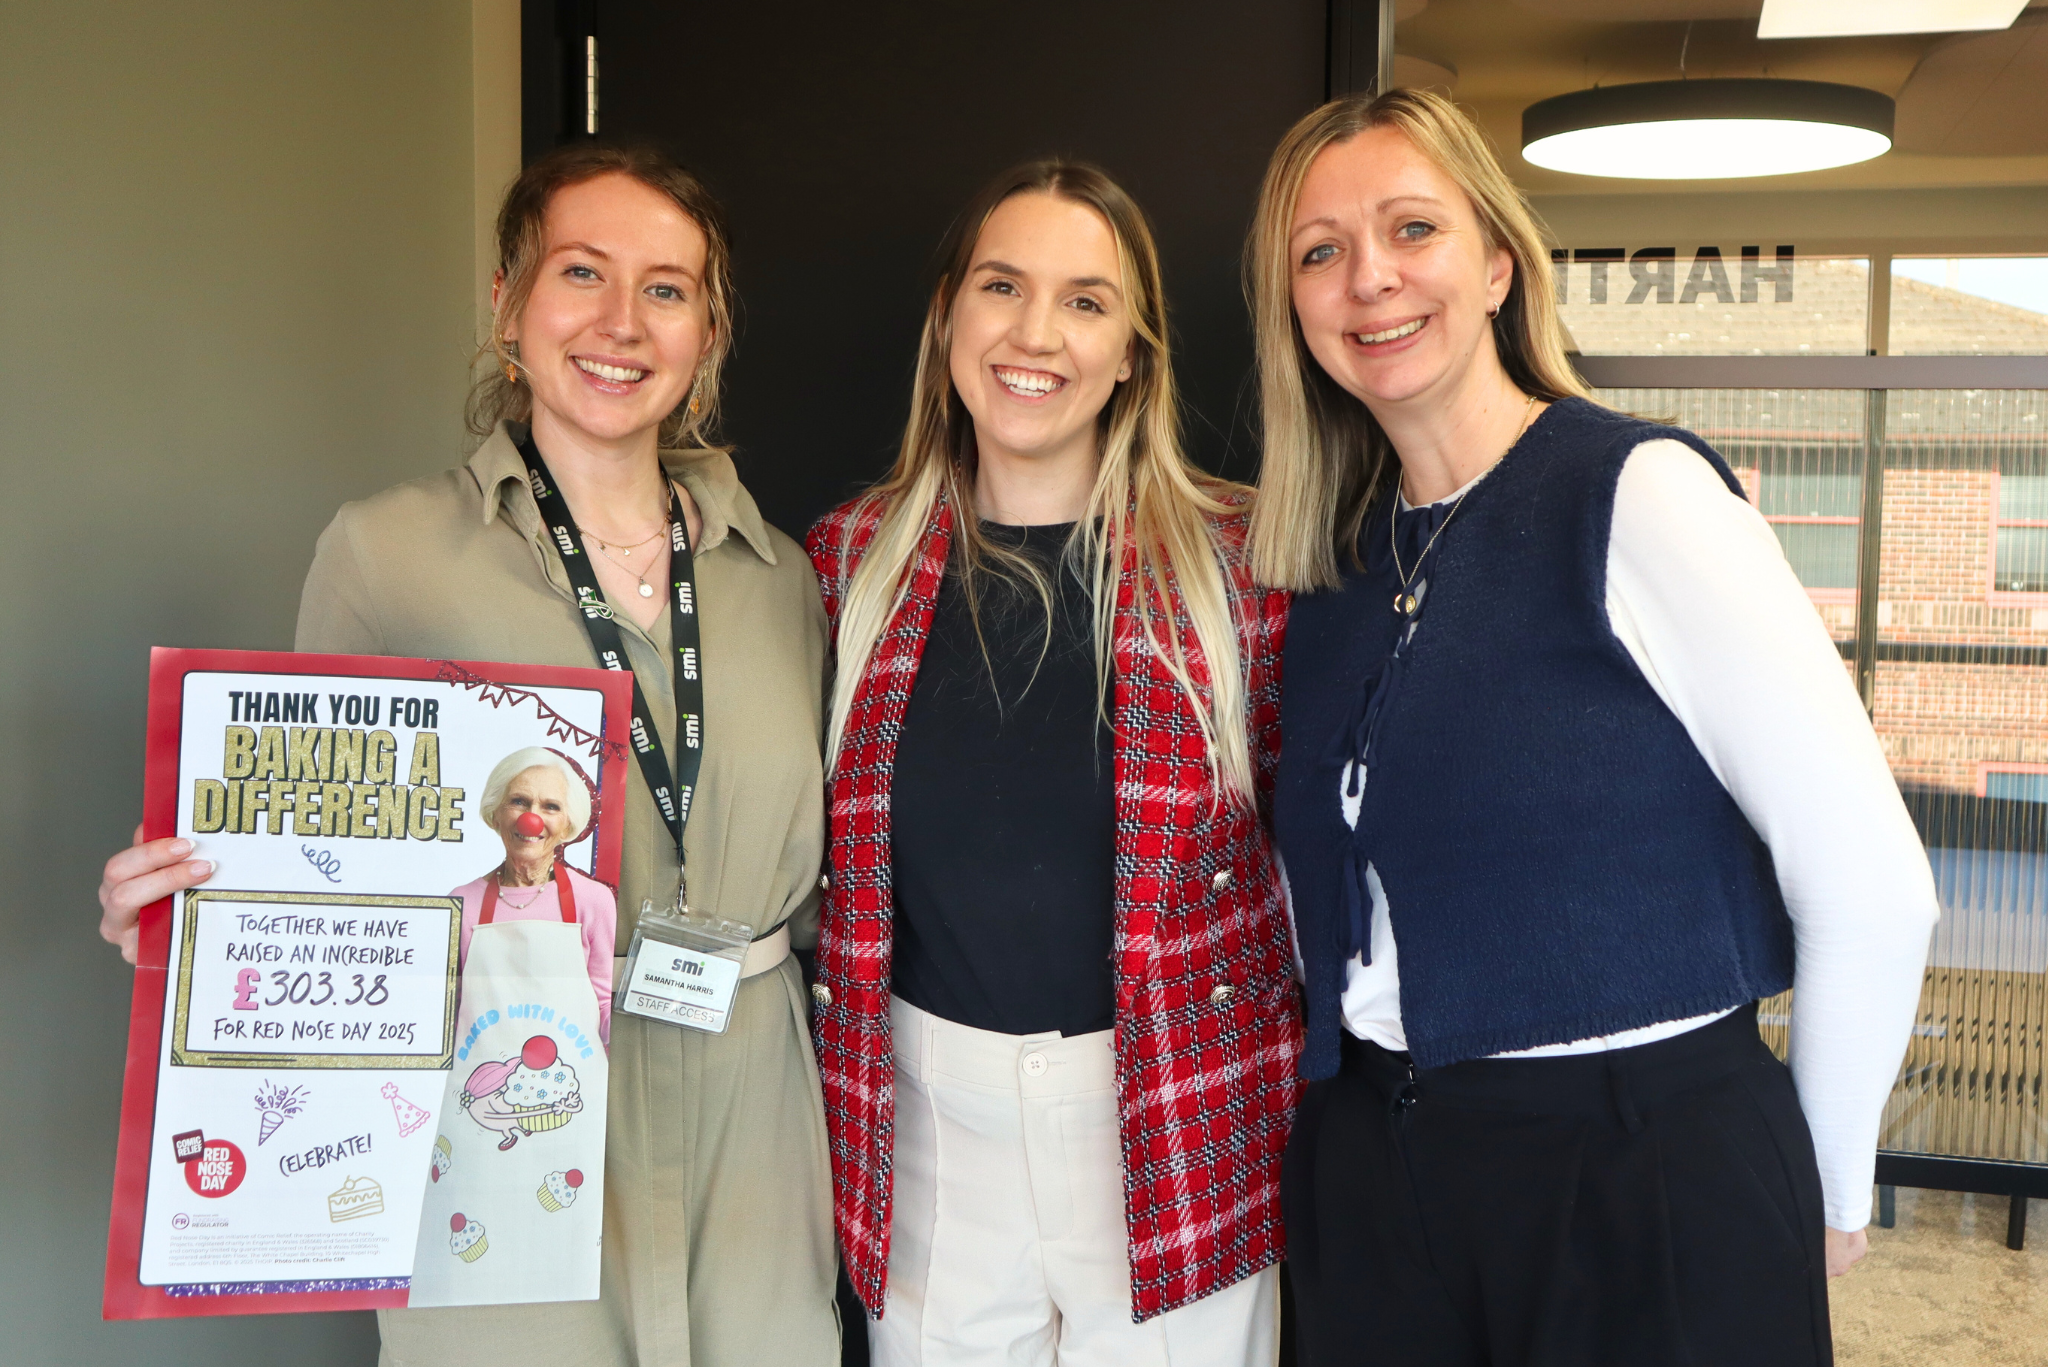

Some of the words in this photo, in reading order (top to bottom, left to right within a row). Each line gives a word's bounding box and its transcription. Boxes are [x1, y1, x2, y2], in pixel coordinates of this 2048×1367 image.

[528, 468, 552, 499] smi
[553, 525, 579, 555] smi
[674, 581, 693, 614] smi
[679, 647, 697, 680] smi
[228, 691, 319, 724] THANK
[328, 694, 380, 726] YOU
[389, 696, 440, 728] FOR
[630, 717, 655, 754] smi
[682, 713, 699, 749] smi
[223, 725, 397, 785] BAKING
[408, 731, 441, 787] A
[192, 778, 466, 842] DIFFERENCE
[656, 786, 678, 822] smi
[236, 914, 327, 936] TOGETHER
[332, 919, 358, 936] WE
[364, 920, 409, 939] HAVE
[226, 942, 283, 963] RAISED
[290, 944, 316, 964] AN
[322, 944, 414, 966] INCREDIBLE
[671, 958, 705, 976] smi
[644, 973, 685, 989] SAMANTHA
[686, 985, 714, 996] HARRIS
[636, 996, 670, 1012] STAFF
[670, 1004, 715, 1023] ACCESS
[213, 1018, 247, 1041] FOR
[252, 1021, 284, 1039] RED
[292, 1020, 335, 1041] NOSE
[341, 1022, 372, 1041] DAY
[378, 1022, 417, 1045] 2025
[457, 1009, 500, 1062] BAKED
[507, 1003, 555, 1024] WITH
[557, 1016, 594, 1060] LOVE
[176, 1135, 202, 1149] COMIC
[177, 1143, 203, 1157] RELIEF
[203, 1147, 230, 1162] RED
[279, 1133, 373, 1177] CELEBRATE!
[197, 1162, 233, 1176] NOSE
[200, 1175, 228, 1190] DAY
